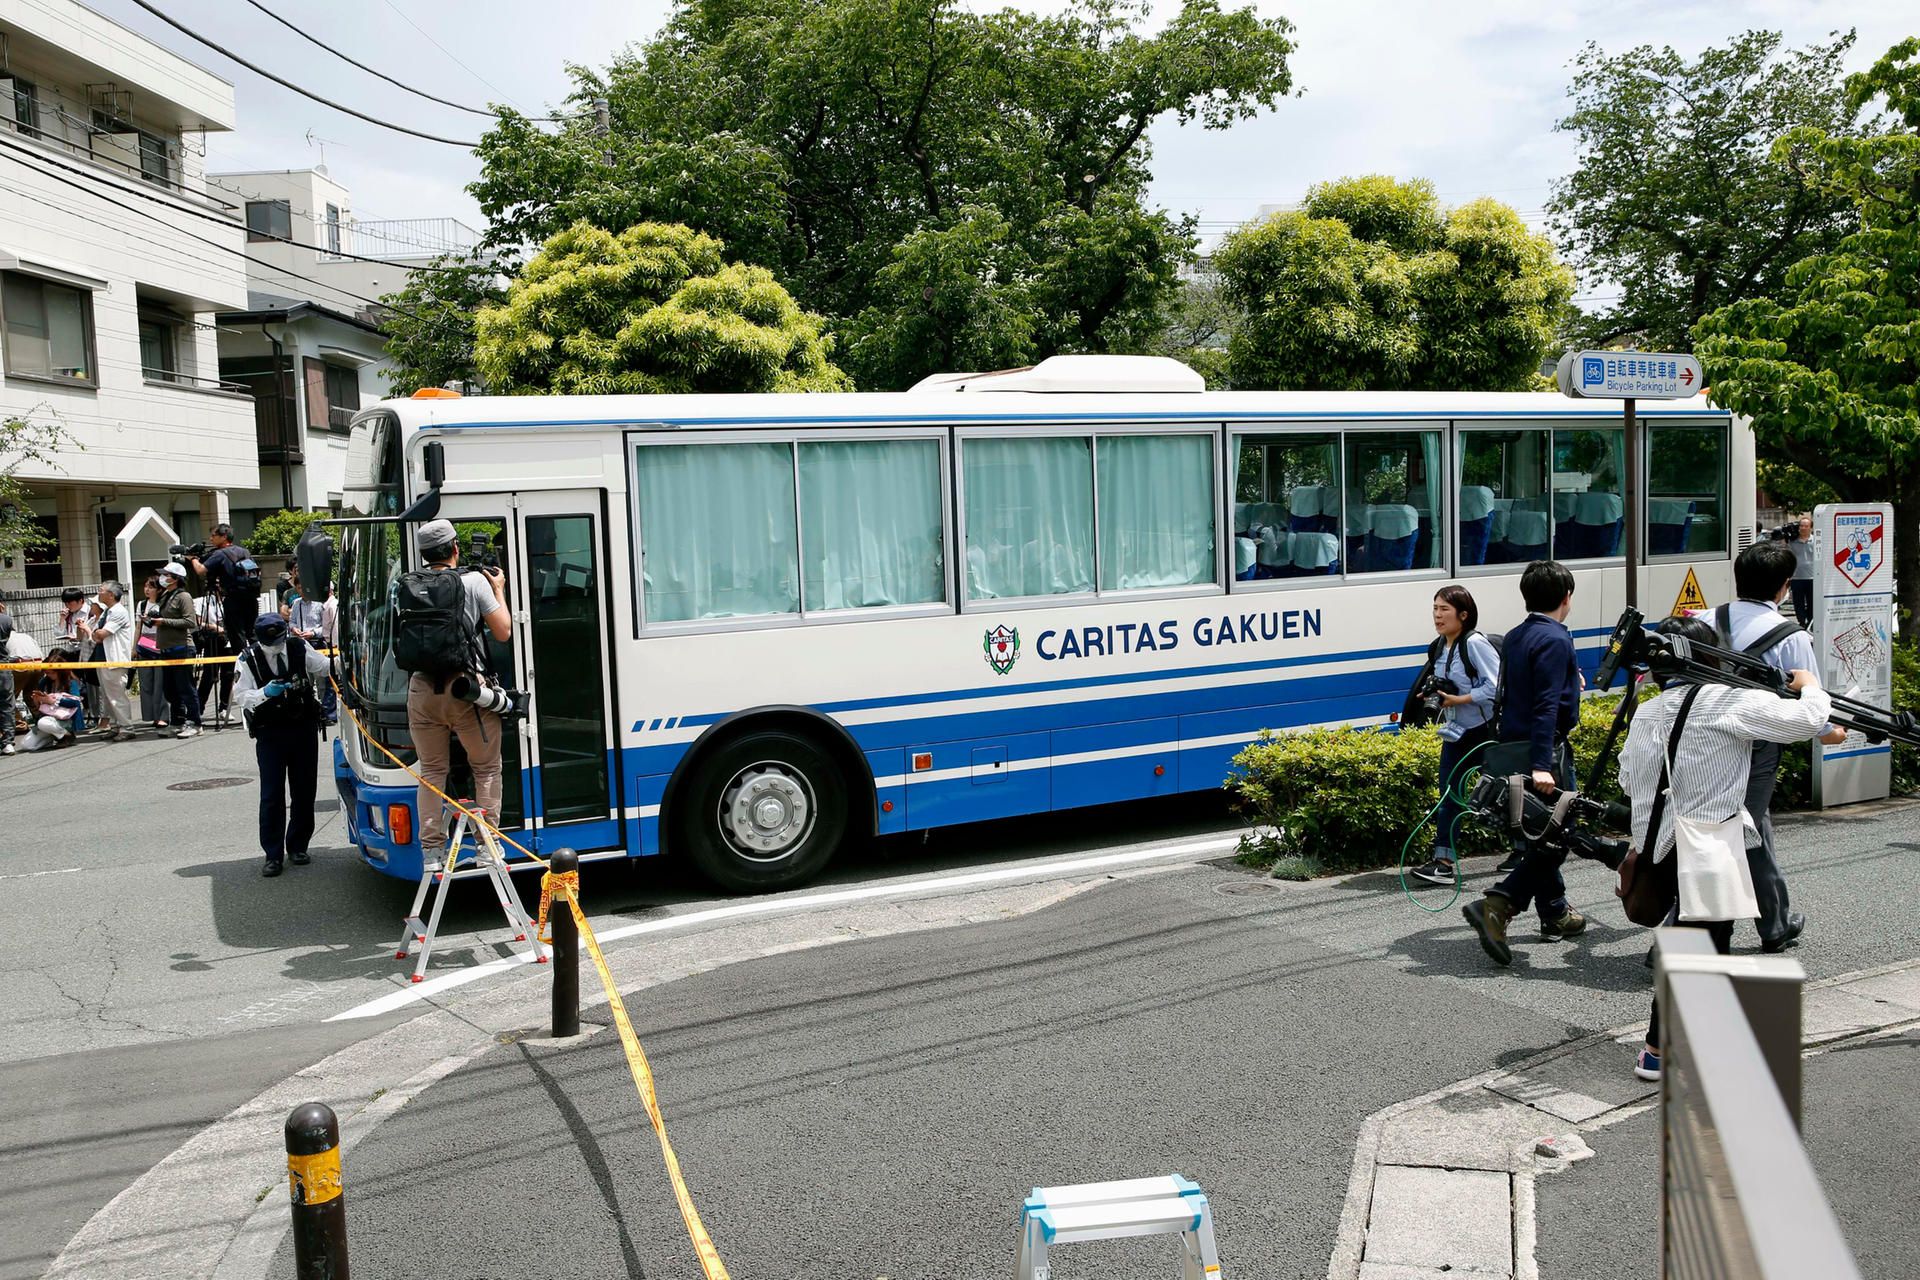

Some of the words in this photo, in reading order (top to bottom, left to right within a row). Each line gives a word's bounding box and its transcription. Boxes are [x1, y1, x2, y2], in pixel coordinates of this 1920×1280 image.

[1607, 360, 1677, 379] 自転車等駐車場
[1607, 380, 1634, 392] Bicycle
[1636, 381, 1663, 394] Parking
[1664, 382, 1677, 392] Lot
[989, 636, 1014, 644] CARITAS
[1036, 620, 1178, 661] CARITAS
[1193, 608, 1322, 646] GAKUEN
[540, 889, 549, 914] KEEP
